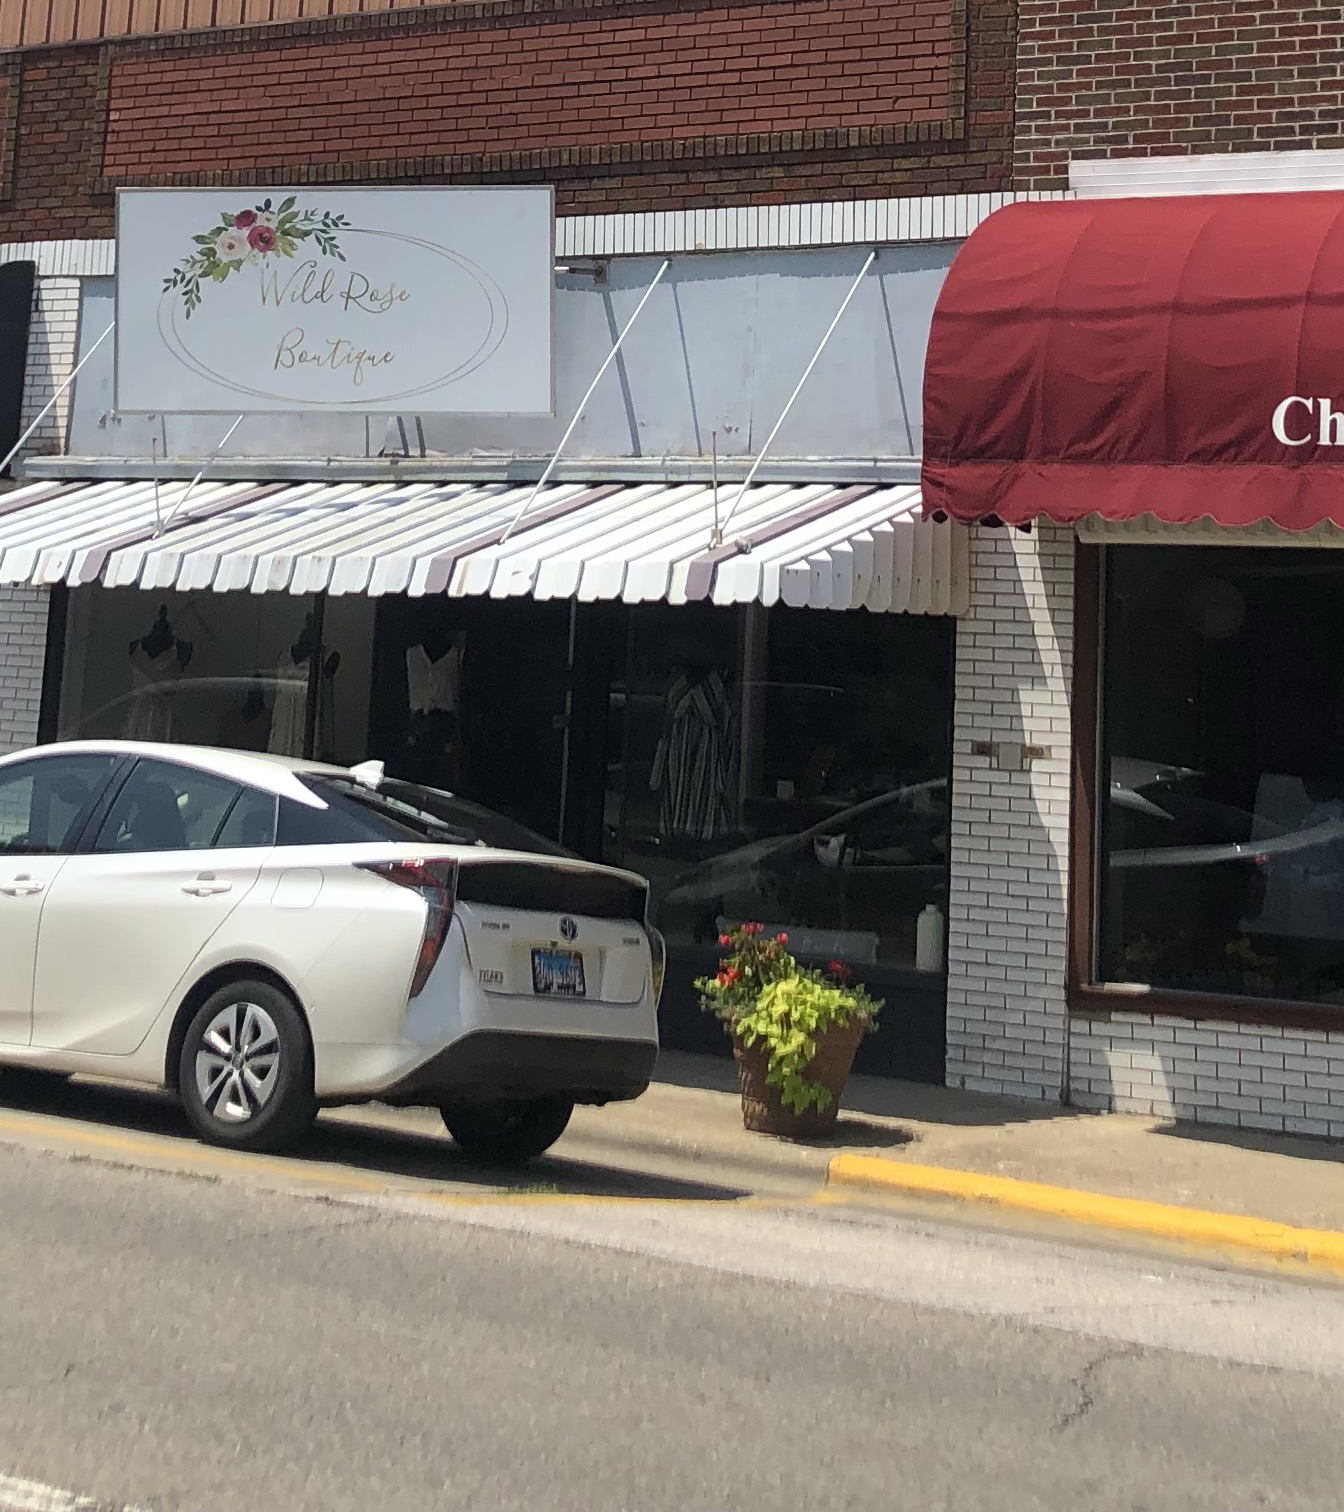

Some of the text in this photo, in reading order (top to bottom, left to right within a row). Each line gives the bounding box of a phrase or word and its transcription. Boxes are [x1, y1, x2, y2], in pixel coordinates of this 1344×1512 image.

[261, 259, 411, 314] Wild Rose
[273, 326, 396, 387] Boutique
